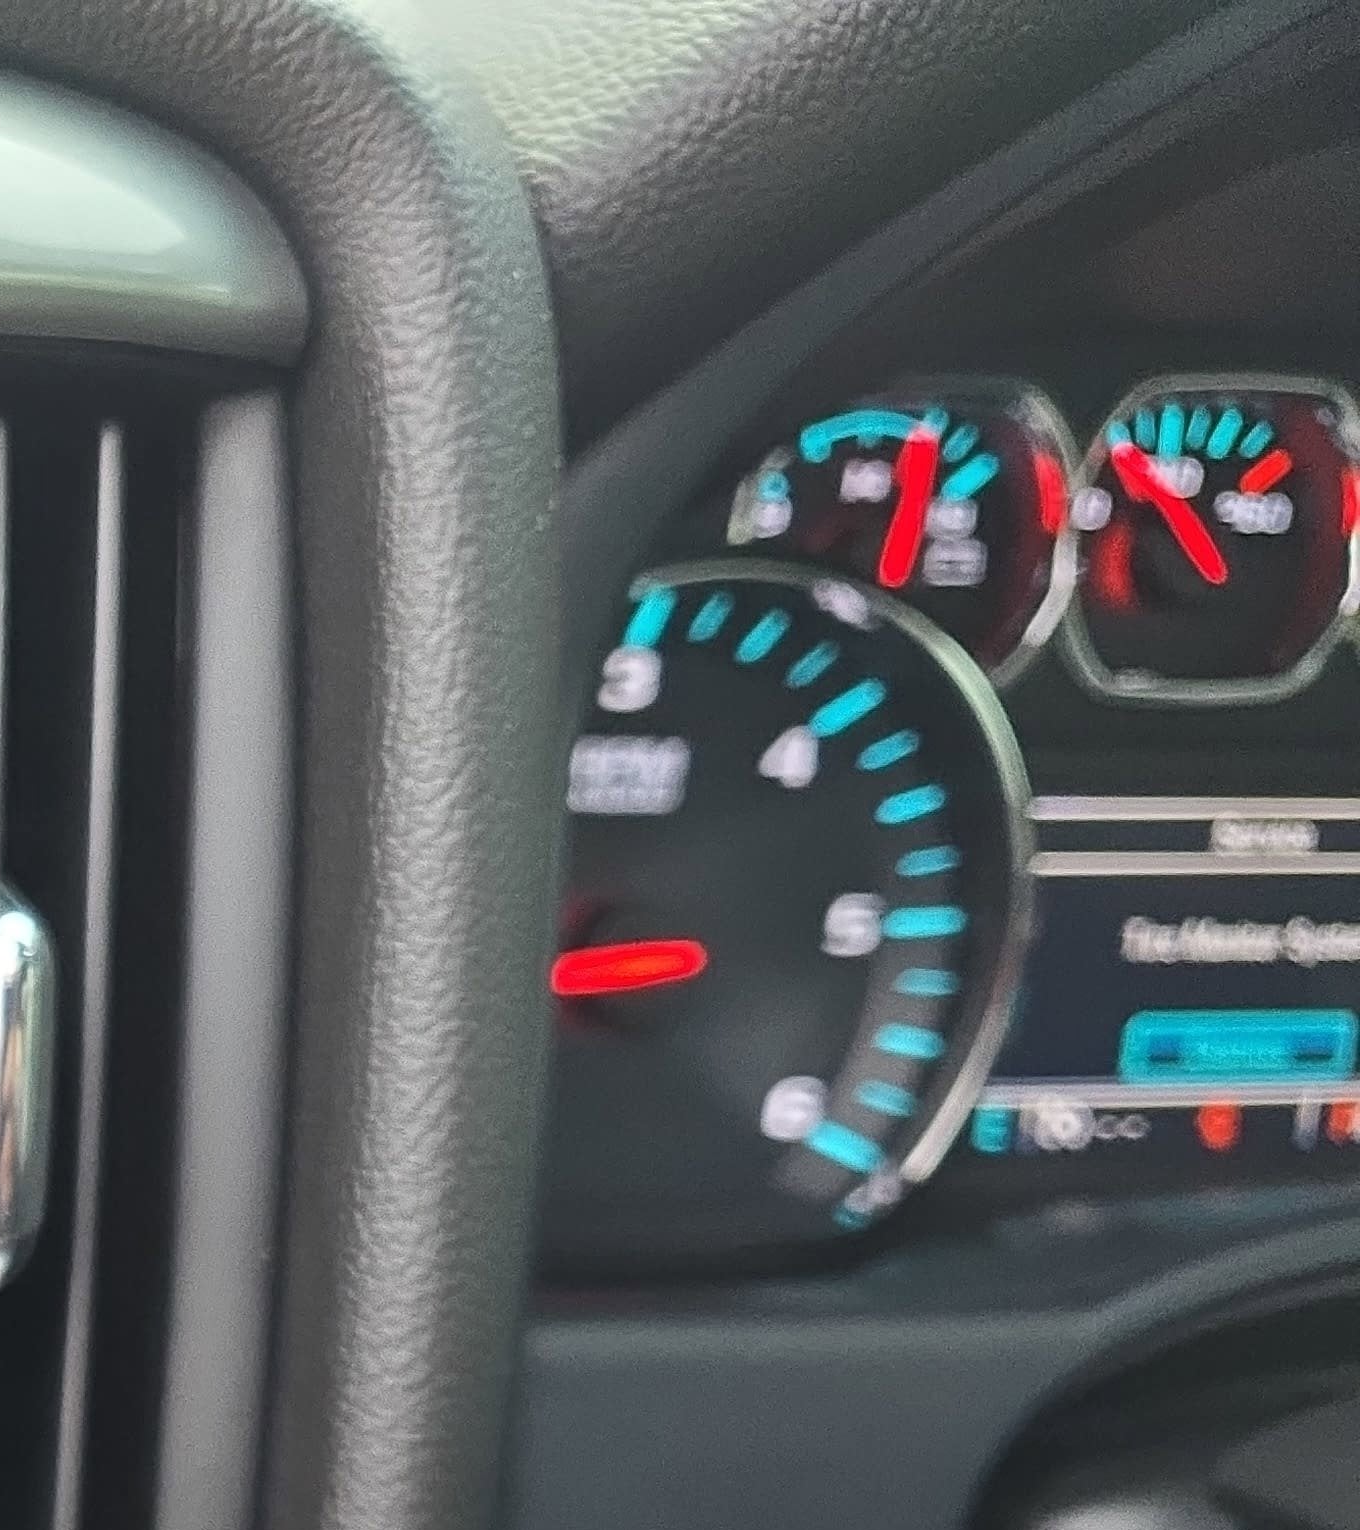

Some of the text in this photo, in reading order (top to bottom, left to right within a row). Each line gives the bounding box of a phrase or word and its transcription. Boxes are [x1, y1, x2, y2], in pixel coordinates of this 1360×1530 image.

[599, 646, 662, 712] 3
[758, 726, 819, 788] 4
[820, 893, 882, 956] 5
[760, 1076, 826, 1140] 6
